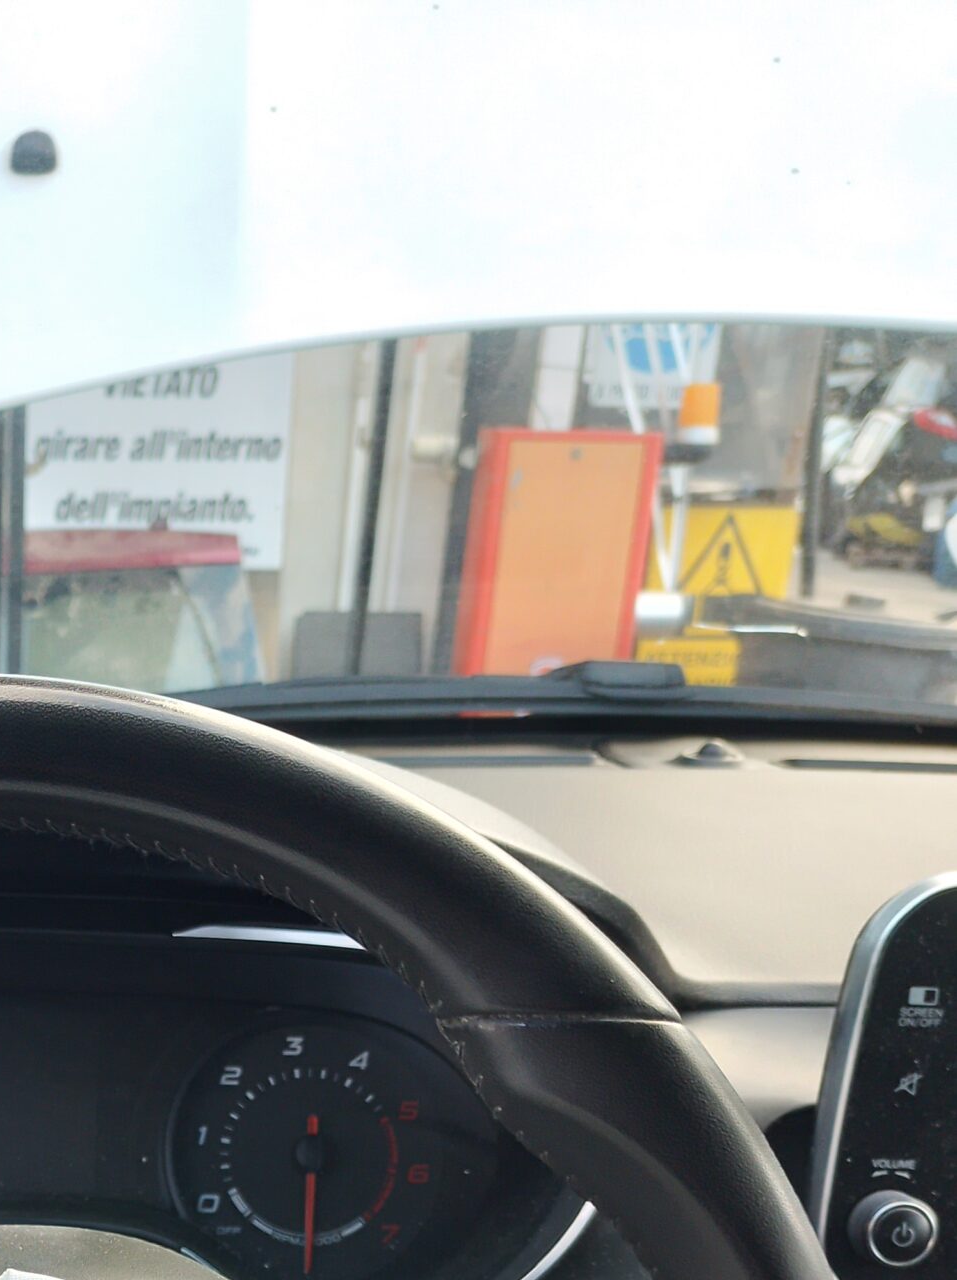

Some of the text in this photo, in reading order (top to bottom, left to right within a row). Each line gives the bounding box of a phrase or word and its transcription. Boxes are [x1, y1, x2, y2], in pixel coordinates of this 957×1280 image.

[35, 426, 283, 463] girare all'interno
[899, 1006, 944, 1018] SCREEN
[898, 1017, 941, 1028] ON/OFF
[282, 1036, 304, 1056] 3
[349, 1051, 370, 1070] 4
[219, 1066, 242, 1086] 2
[399, 1100, 419, 1120] 5
[198, 1126, 208, 1146] 1
[408, 1164, 430, 1184] 6
[871, 1158, 916, 1170] VOLUME
[197, 1194, 220, 1213] 0
[380, 1225, 400, 1245] 7
